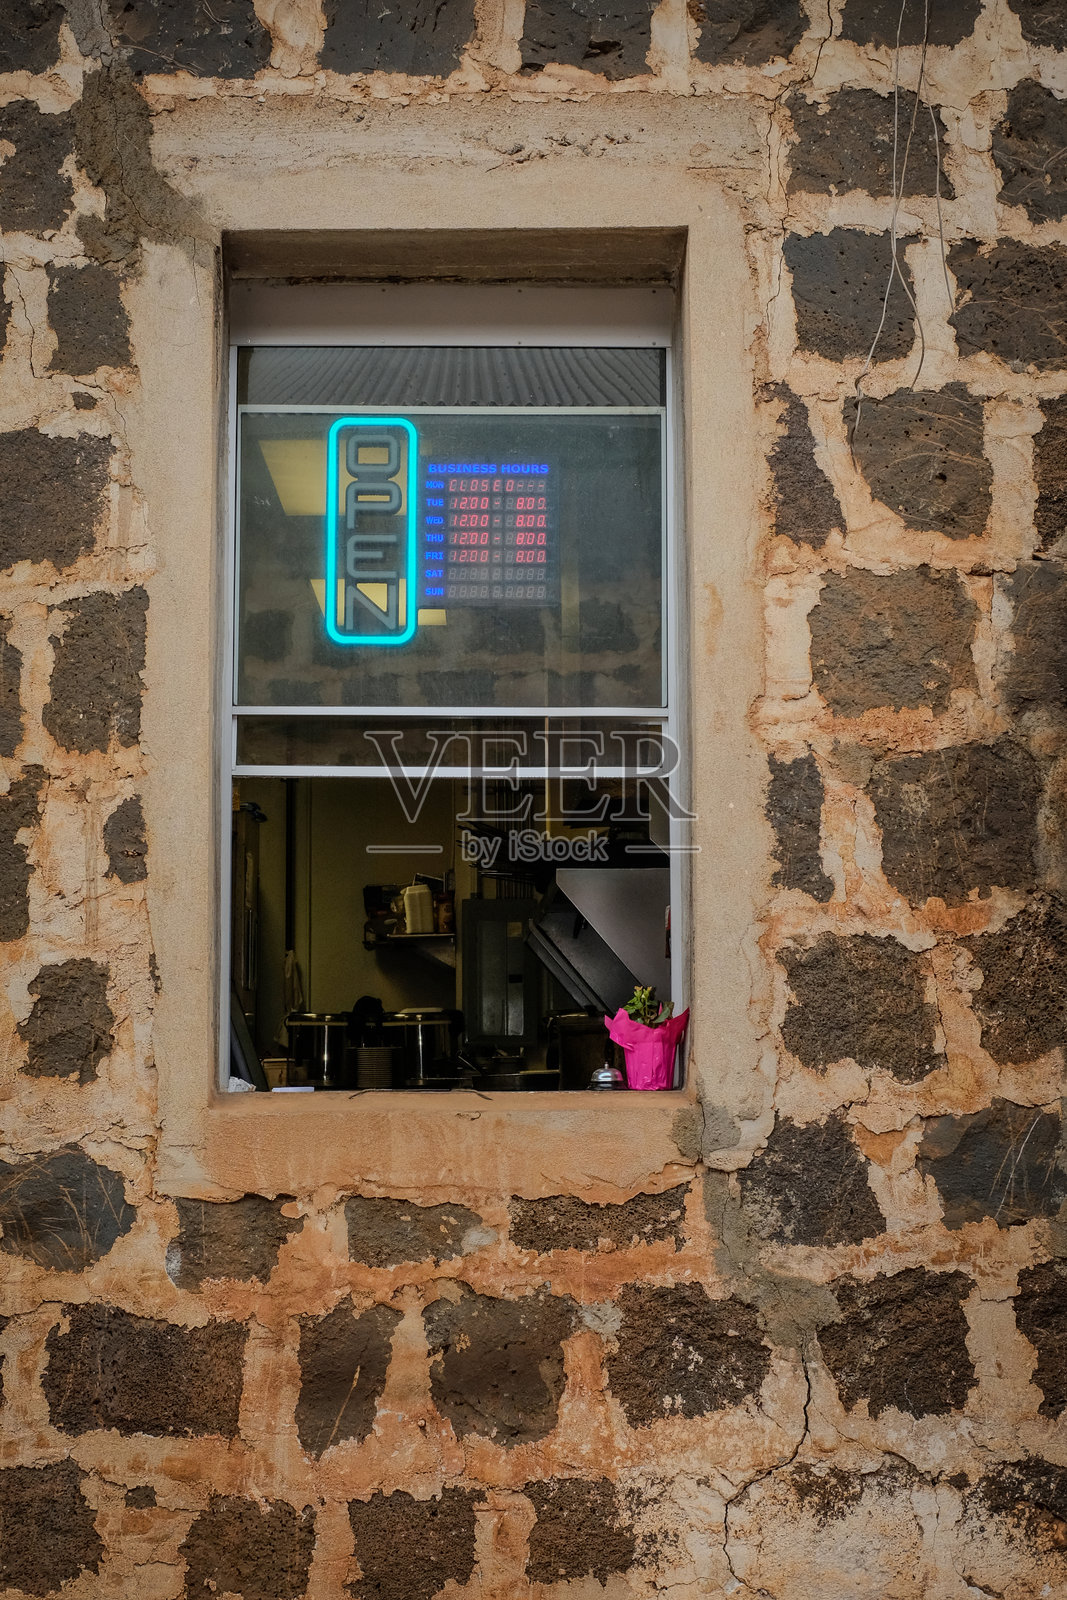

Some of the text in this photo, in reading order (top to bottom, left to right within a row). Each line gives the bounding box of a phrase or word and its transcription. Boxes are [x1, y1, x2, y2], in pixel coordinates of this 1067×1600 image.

[428, 464, 549, 474] BUSINESS HOURS
[425, 481, 445, 489] MON
[426, 498, 444, 507] TUE
[425, 516, 444, 525] WED
[346, 434, 402, 631] OPEN
[425, 534, 444, 543] THU
[425, 552, 444, 561] FRI
[425, 569, 444, 578] SAT
[425, 587, 444, 596] SUN
